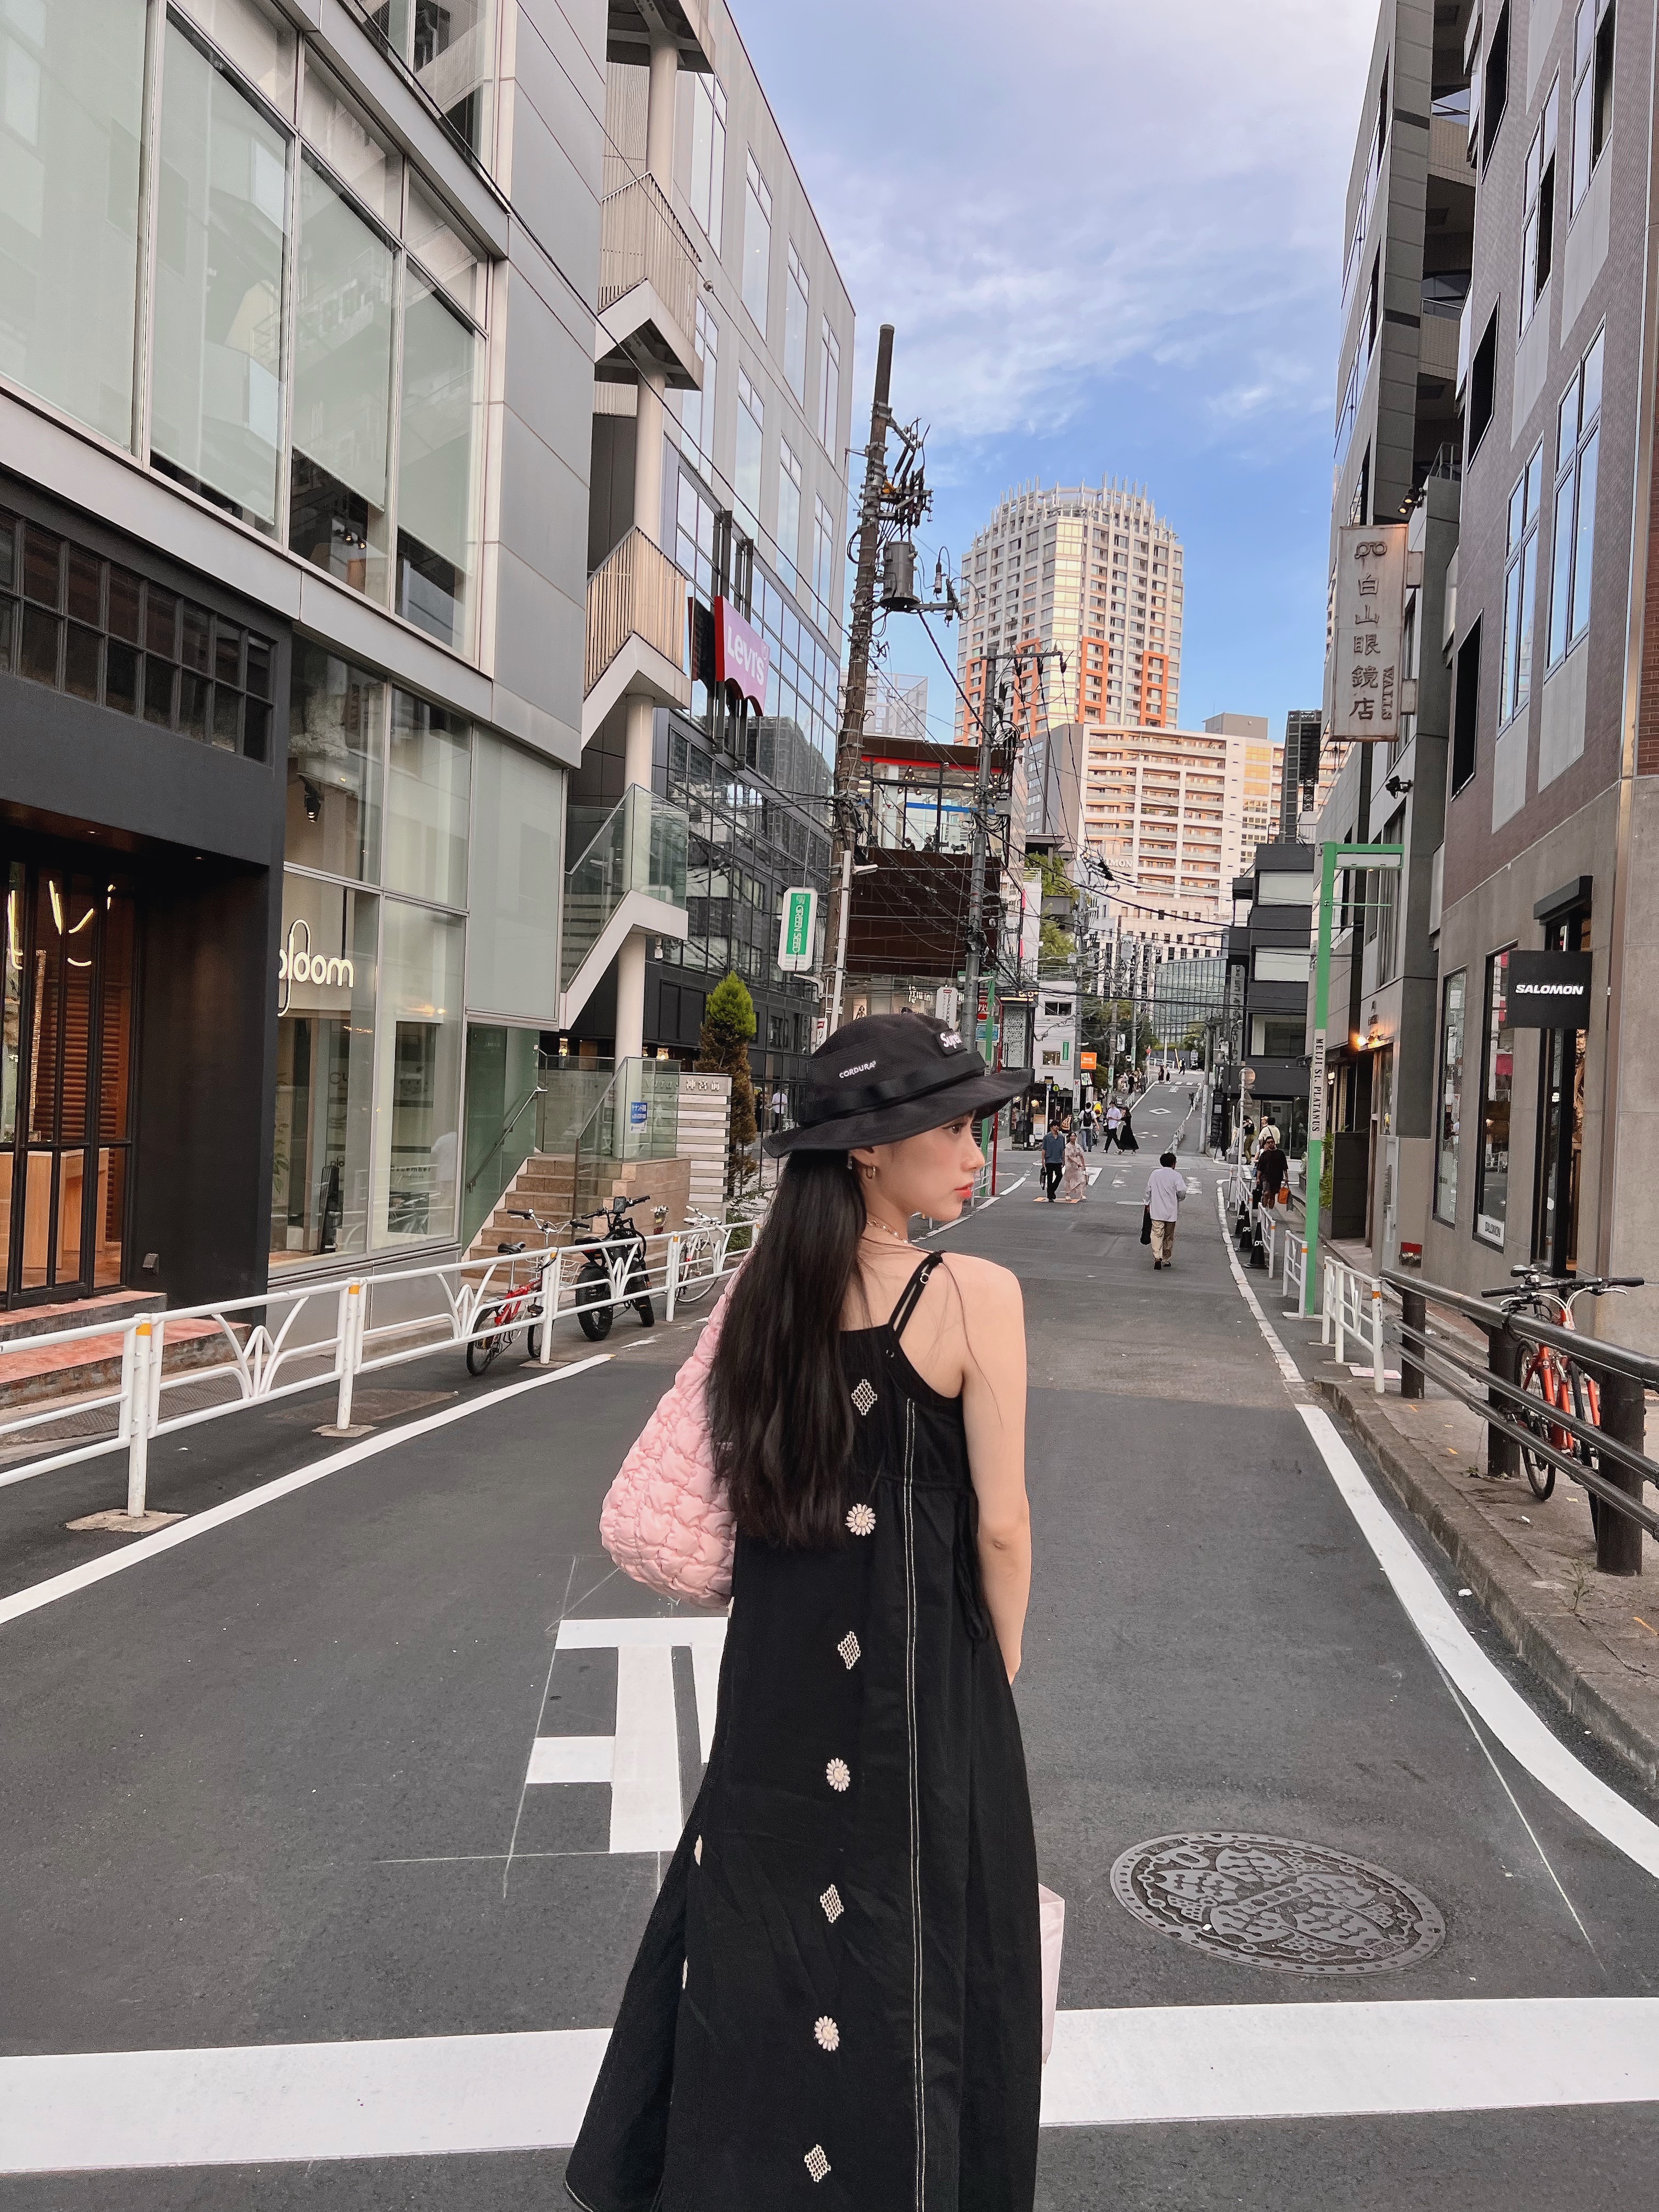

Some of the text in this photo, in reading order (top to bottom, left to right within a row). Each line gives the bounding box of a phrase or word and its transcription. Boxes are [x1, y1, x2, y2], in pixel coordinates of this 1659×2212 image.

[1348, 574, 1381, 721] 白山眼鏡店
[793, 905, 804, 932] GREEN
[792, 932, 802, 953] SEED
[1515, 984, 1584, 996] SALOMON
[1311, 1038, 1324, 1132] MEIJI St. PLATANUS
